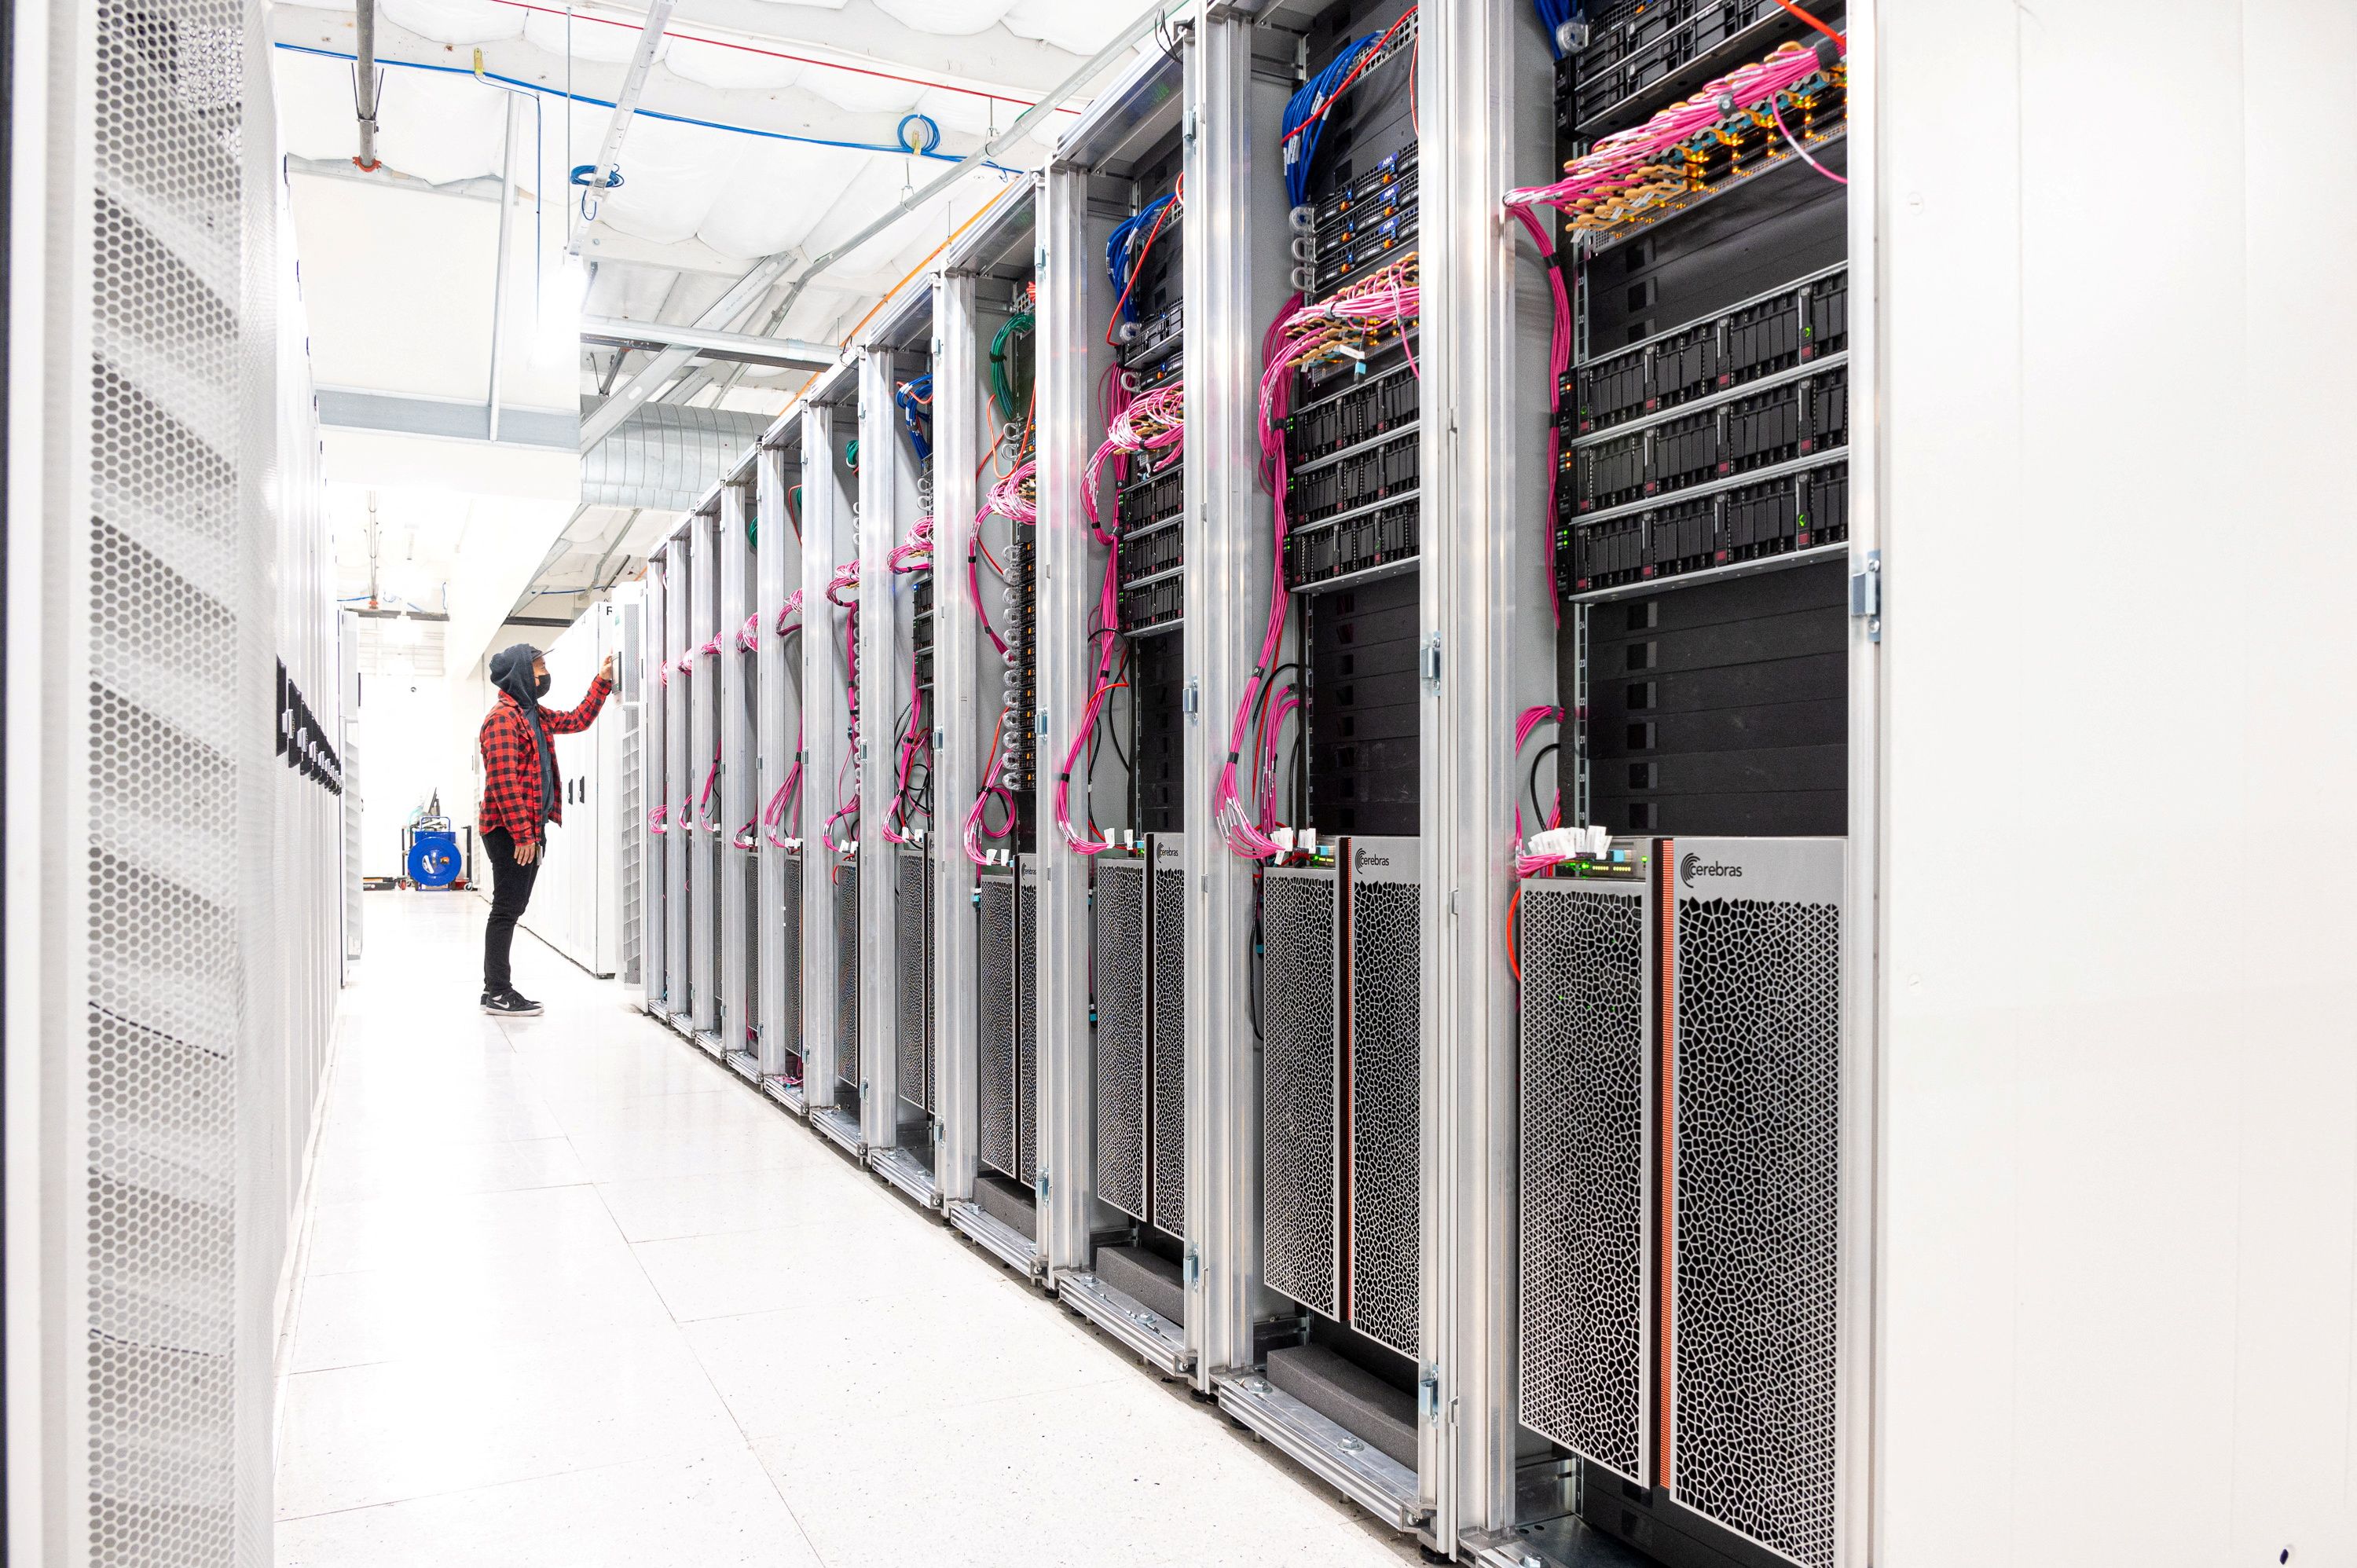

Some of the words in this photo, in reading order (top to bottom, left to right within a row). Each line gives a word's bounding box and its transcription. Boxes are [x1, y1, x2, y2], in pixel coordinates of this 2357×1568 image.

[1579, 697, 1585, 706] 22
[1579, 735, 1585, 744] 21
[1579, 773, 1585, 782] 20
[1579, 811, 1585, 820] 19
